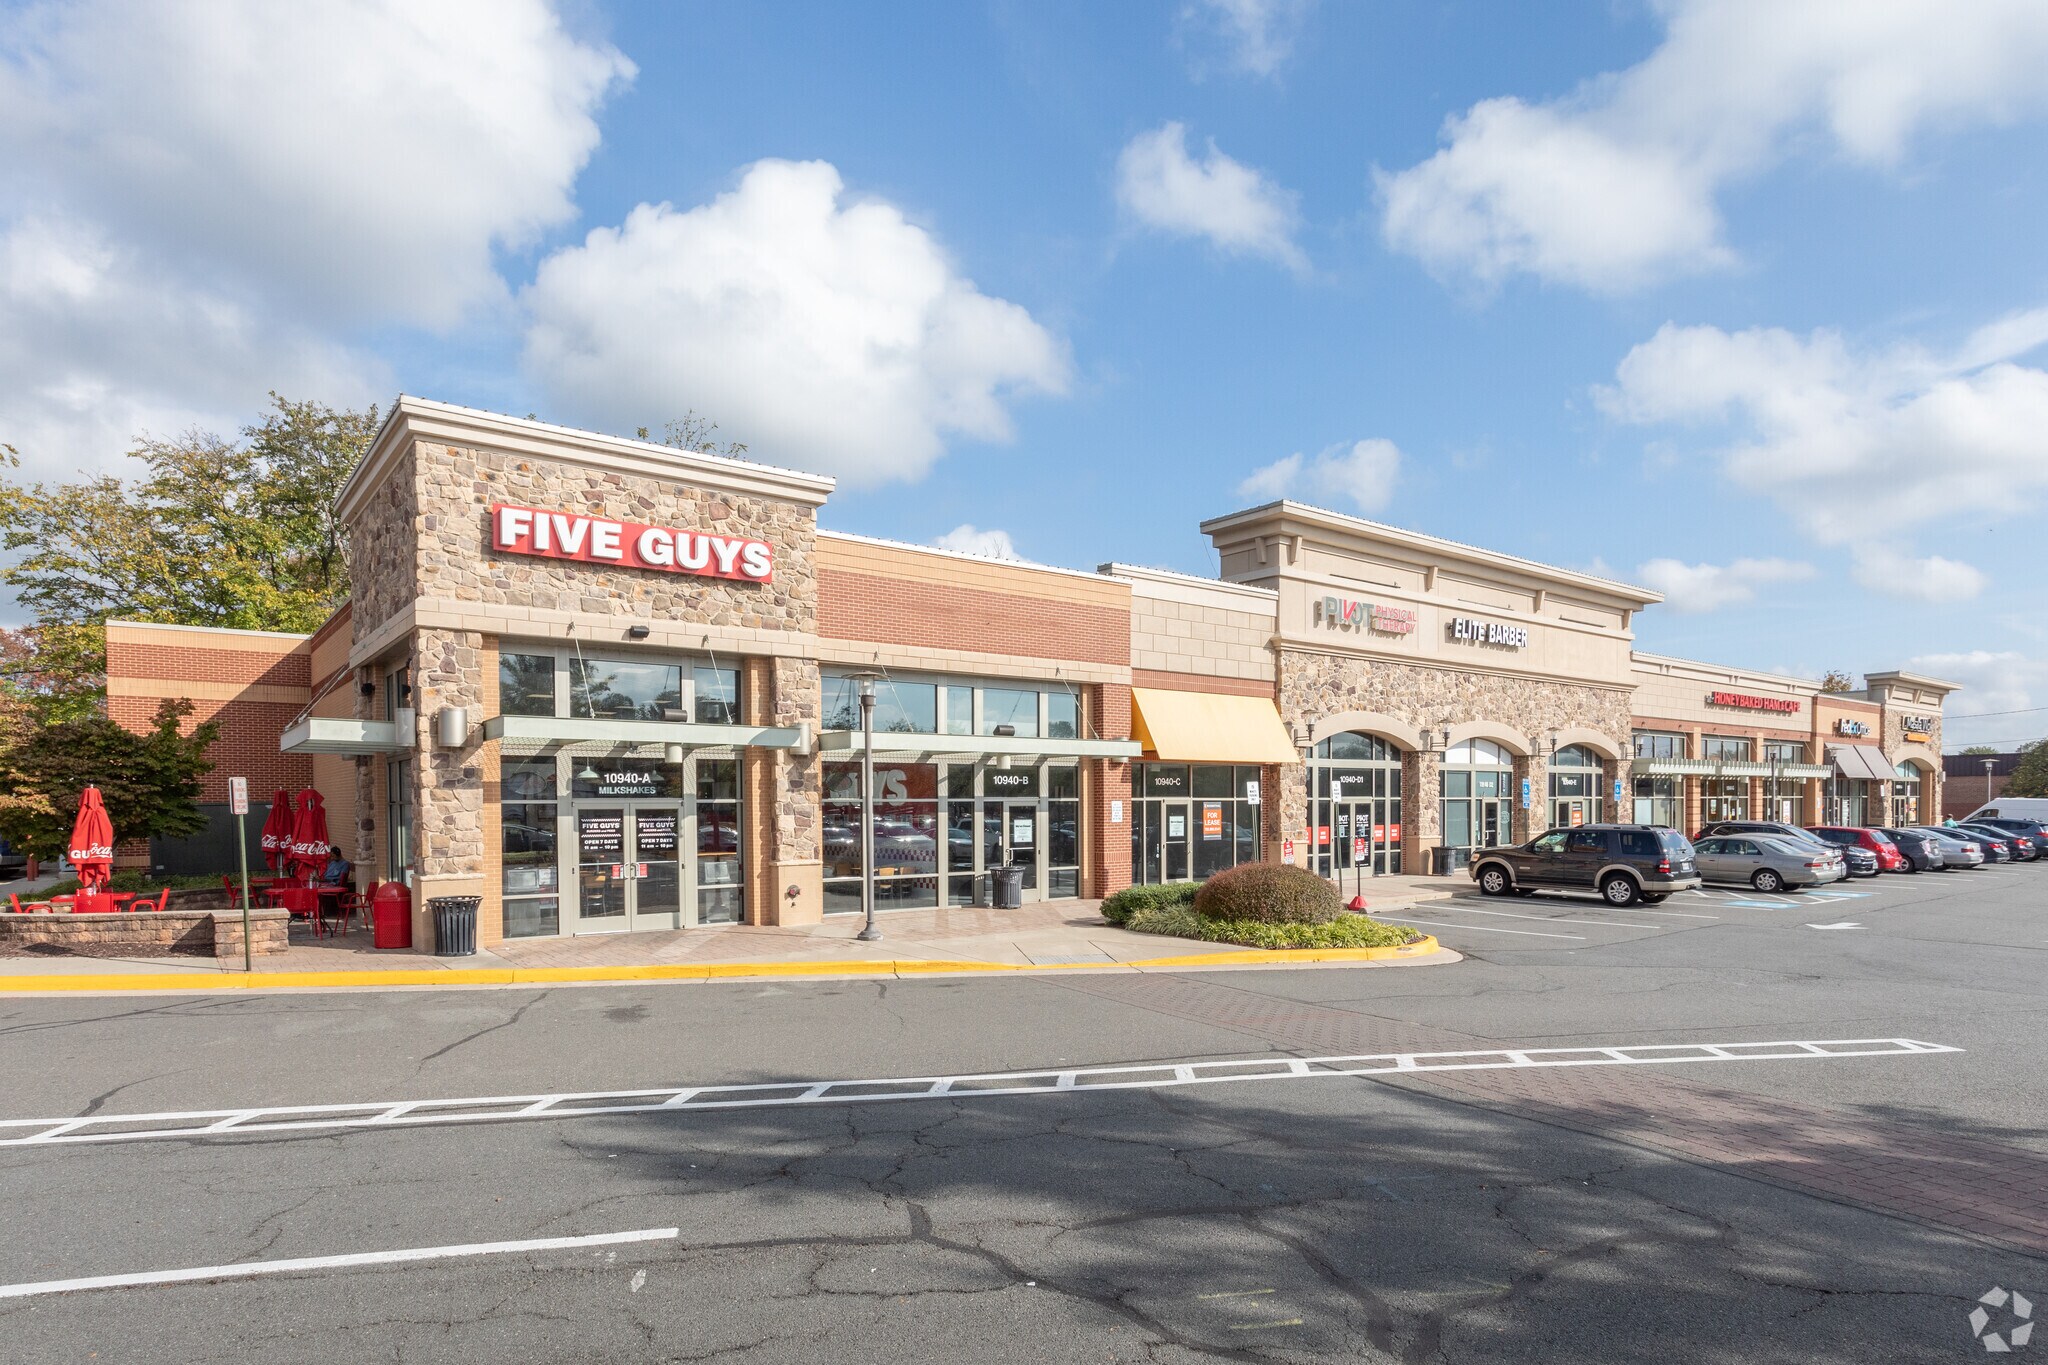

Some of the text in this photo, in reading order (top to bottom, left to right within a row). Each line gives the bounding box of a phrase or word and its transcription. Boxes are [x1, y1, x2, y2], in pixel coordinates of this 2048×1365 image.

[500, 507, 772, 578] FIVE GUYS
[1322, 596, 1416, 628] PIVOT PHYSICAL
[1377, 617, 1415, 634] THERAPY
[1454, 618, 1528, 647] ELITE BARBER
[1763, 698, 1781, 710] HAM
[604, 773, 650, 783] 10940-A
[993, 775, 1029, 785] 10940-B
[1155, 777, 1181, 786] 10940-C
